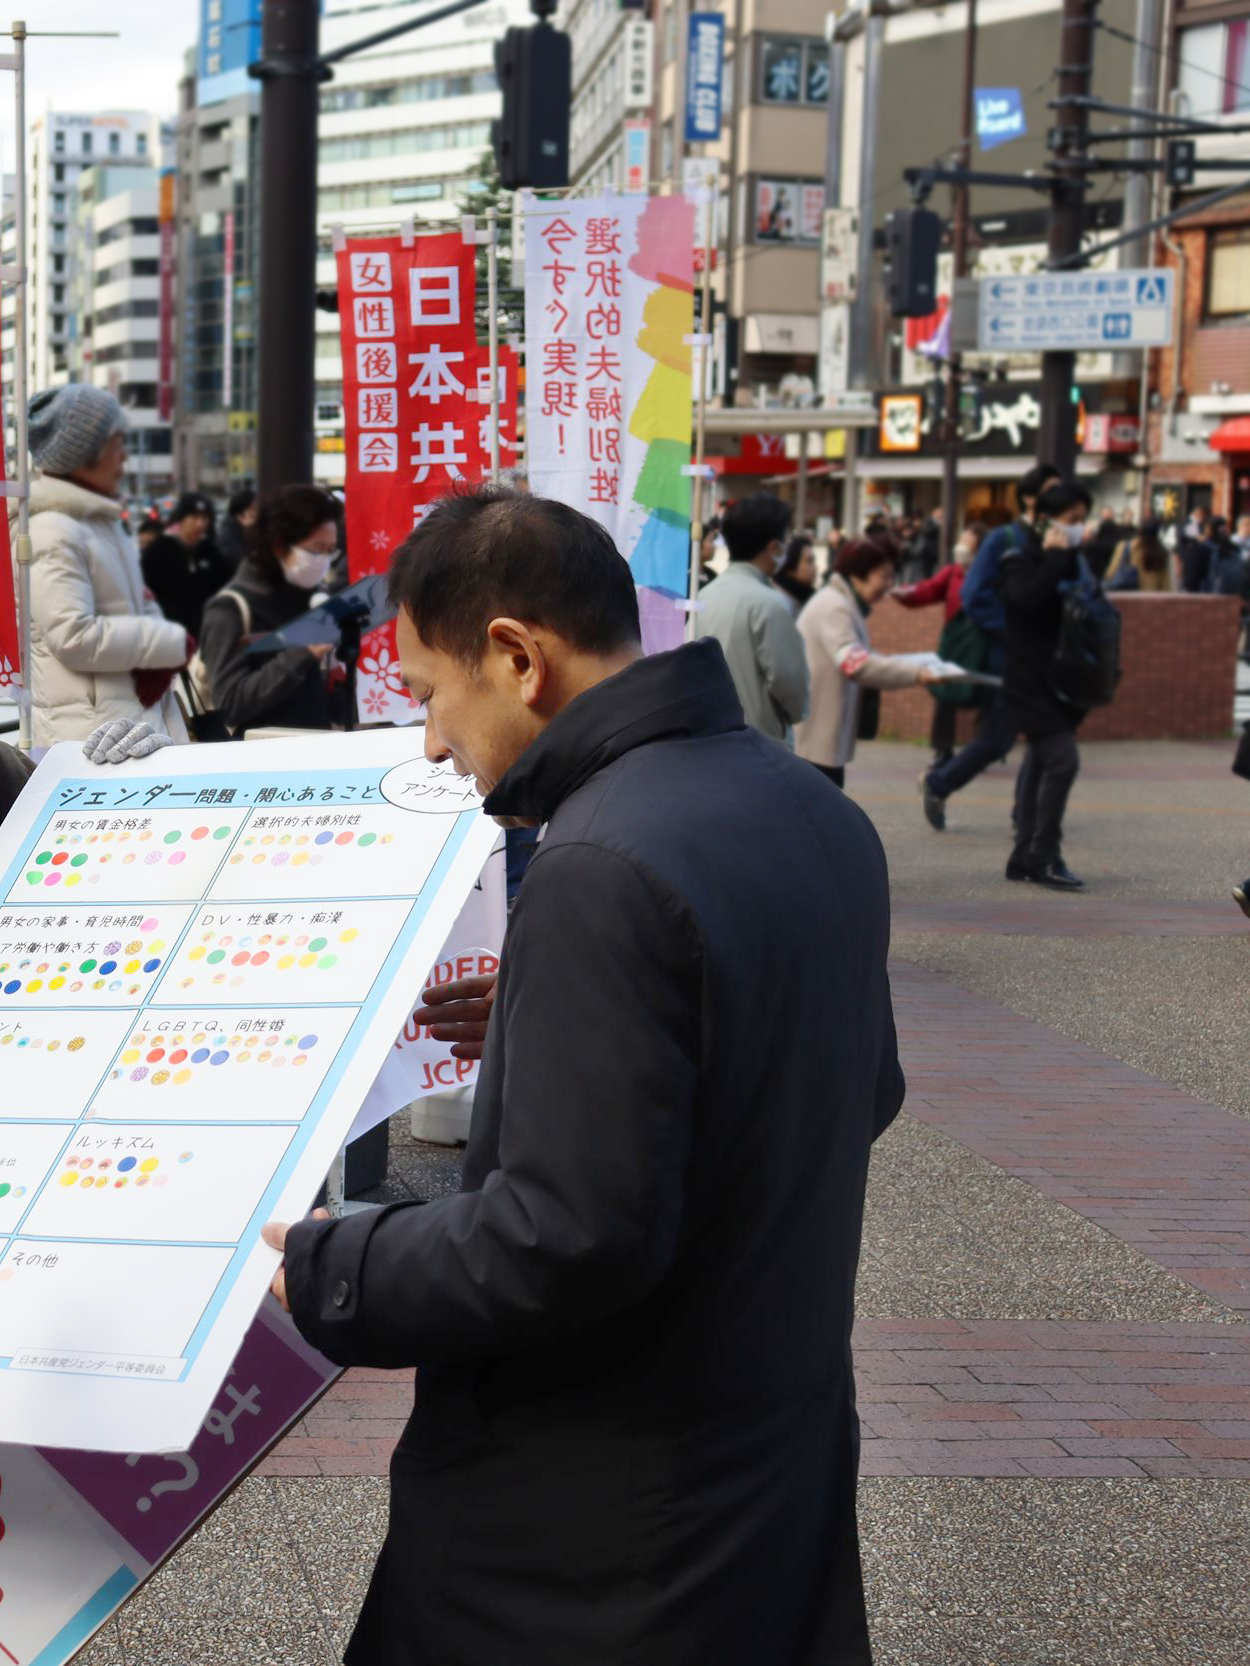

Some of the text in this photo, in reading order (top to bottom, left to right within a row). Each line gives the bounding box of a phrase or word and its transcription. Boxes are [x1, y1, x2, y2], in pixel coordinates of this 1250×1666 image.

[356, 257, 395, 468] 女性後援会
[407, 265, 468, 528] 日本共
[59, 783, 377, 806] ジェンダー問題・関心あること
[400, 783, 476, 802] アンケート
[54, 817, 153, 831] 男女の賃金格差
[251, 813, 363, 829] 選択的夫婦別姓
[0, 915, 144, 929] 男女の家事・育児時間
[76, 1135, 154, 1149] ルッキズム
[12, 1252, 59, 1268] その他
